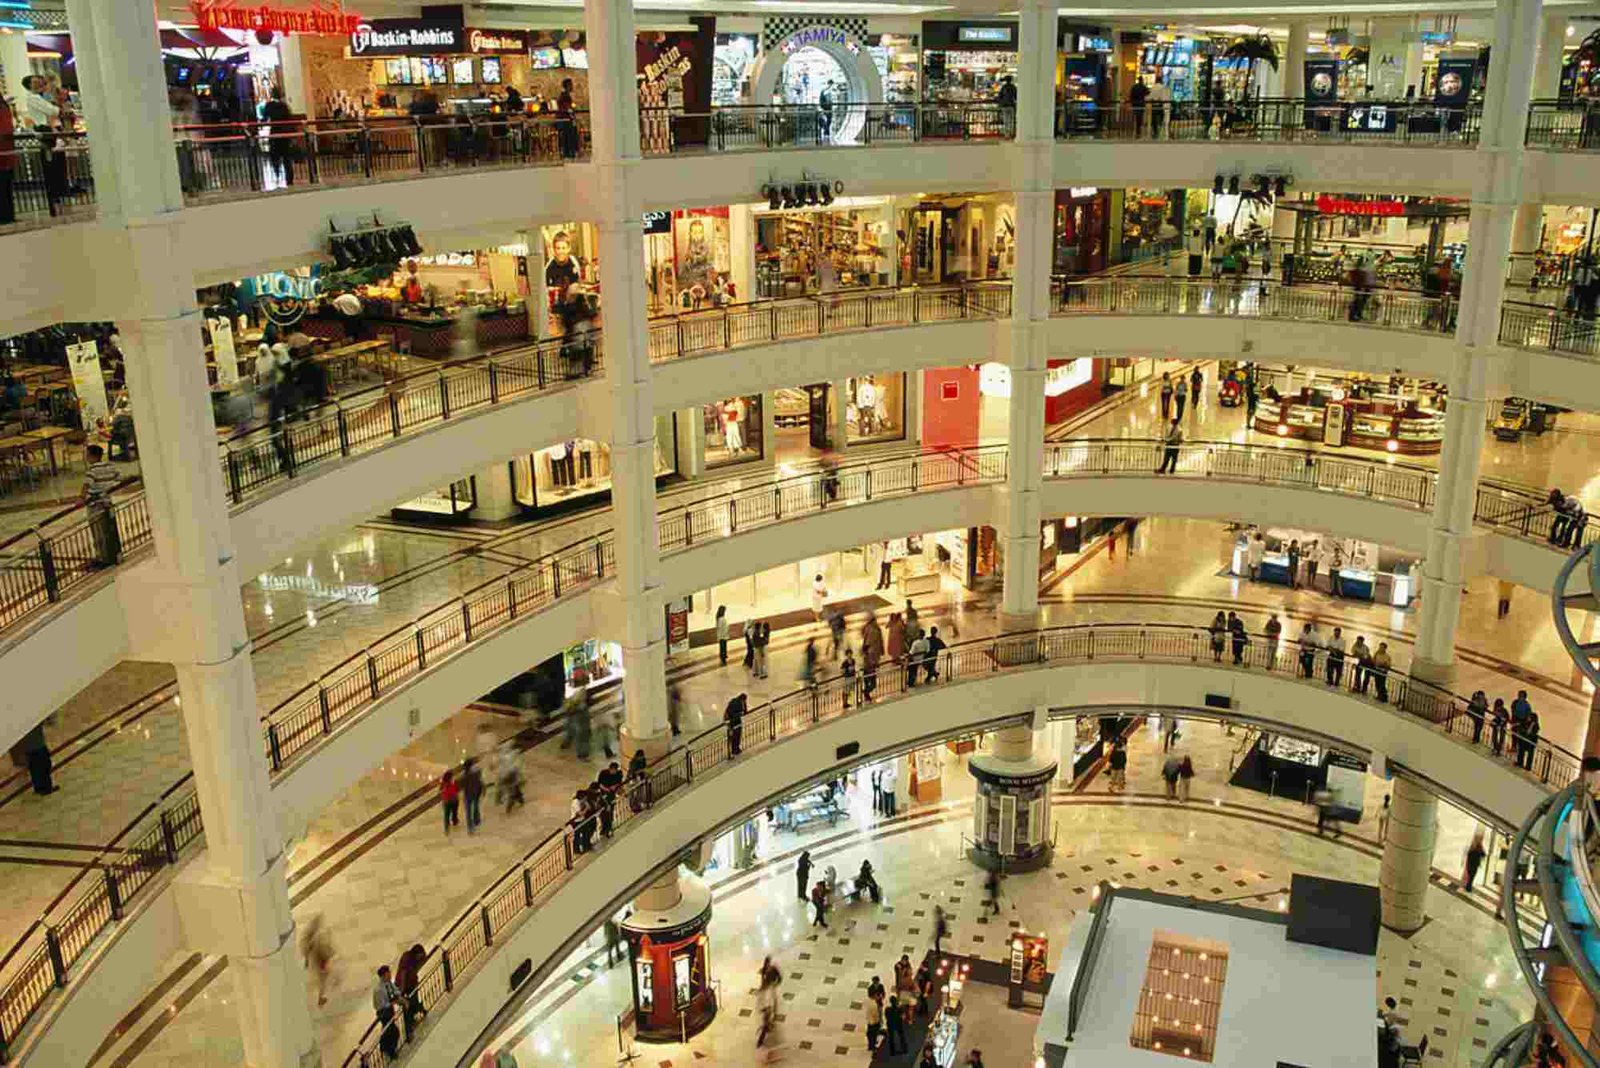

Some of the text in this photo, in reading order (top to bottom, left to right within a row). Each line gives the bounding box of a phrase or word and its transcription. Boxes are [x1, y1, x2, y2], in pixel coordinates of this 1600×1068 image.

[371, 27, 455, 47] Baskin-Robbins
[794, 27, 845, 46] TAMIYA
[255, 271, 322, 301] PICNIC
